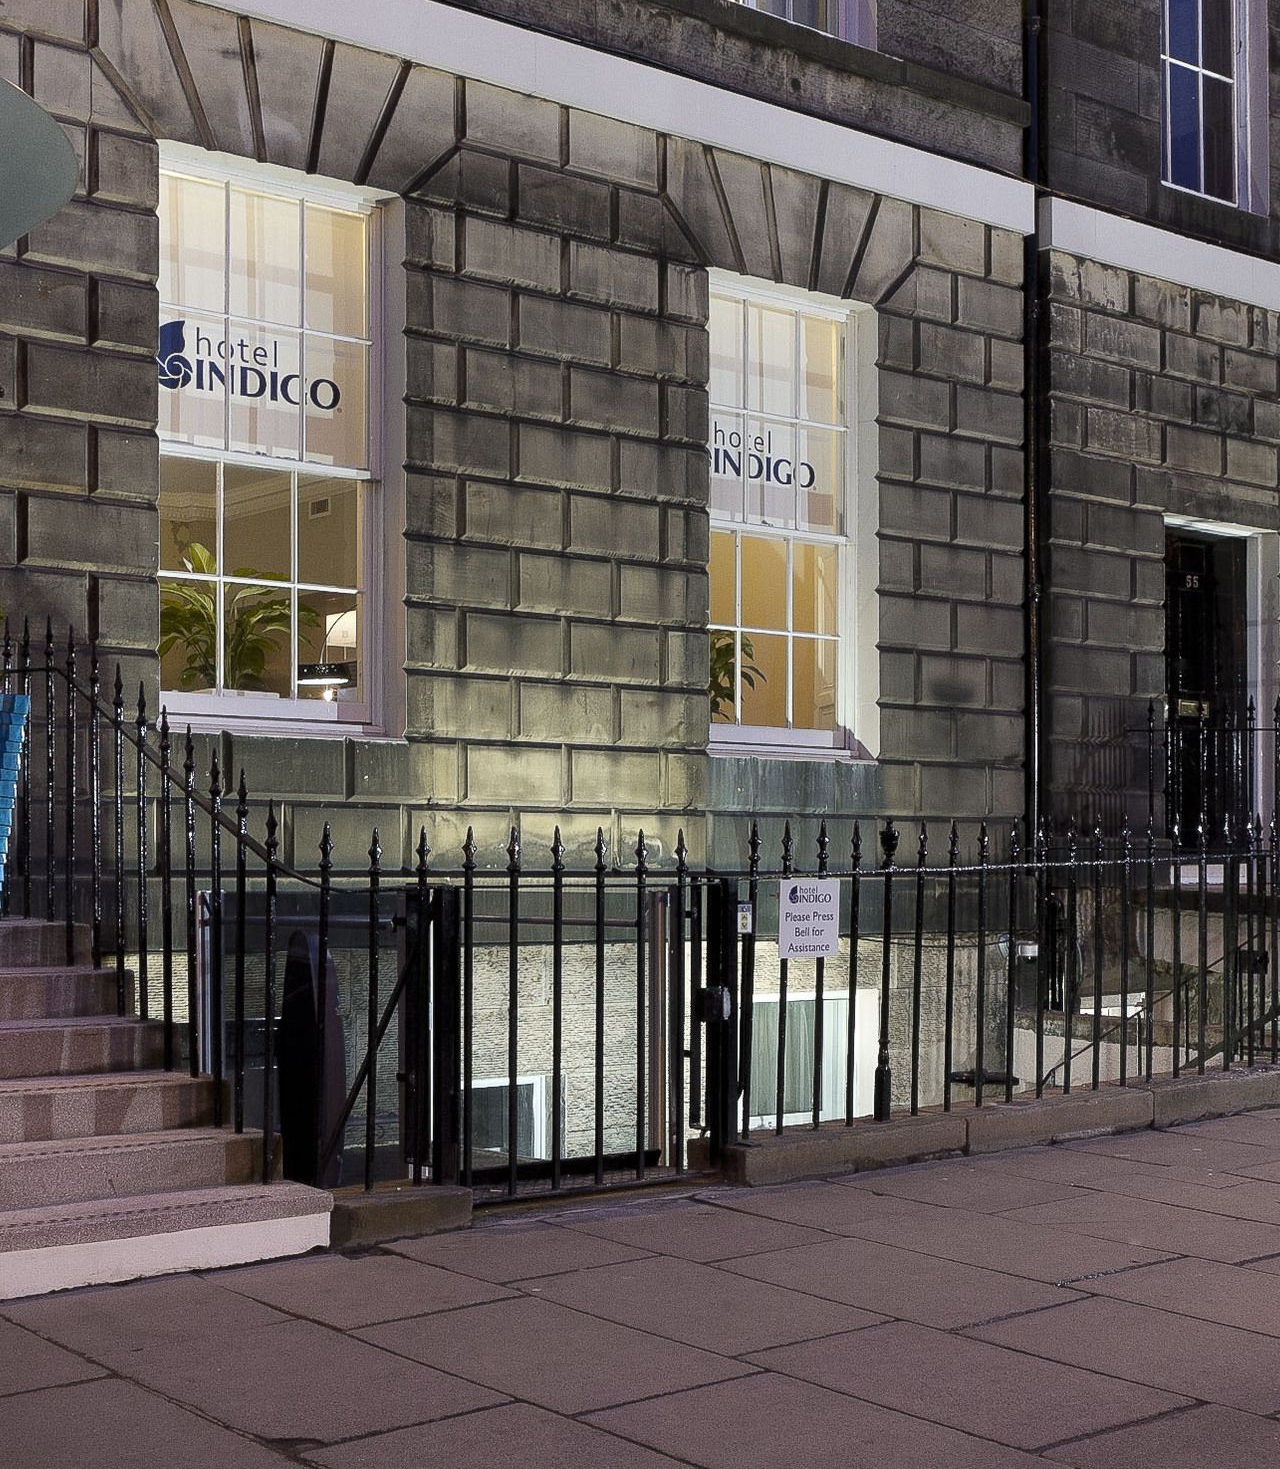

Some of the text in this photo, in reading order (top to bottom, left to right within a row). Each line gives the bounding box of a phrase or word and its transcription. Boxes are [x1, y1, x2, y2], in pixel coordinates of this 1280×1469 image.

[196, 327, 278, 367] hotel
[195, 359, 341, 411] INDIGO
[714, 448, 815, 489] INDIGO
[799, 886, 818, 894] hotel
[799, 893, 832, 903] INDIGO
[785, 911, 834, 922] Please Press
[794, 926, 825, 937] Bell for
[787, 942, 830, 953] Assistance
